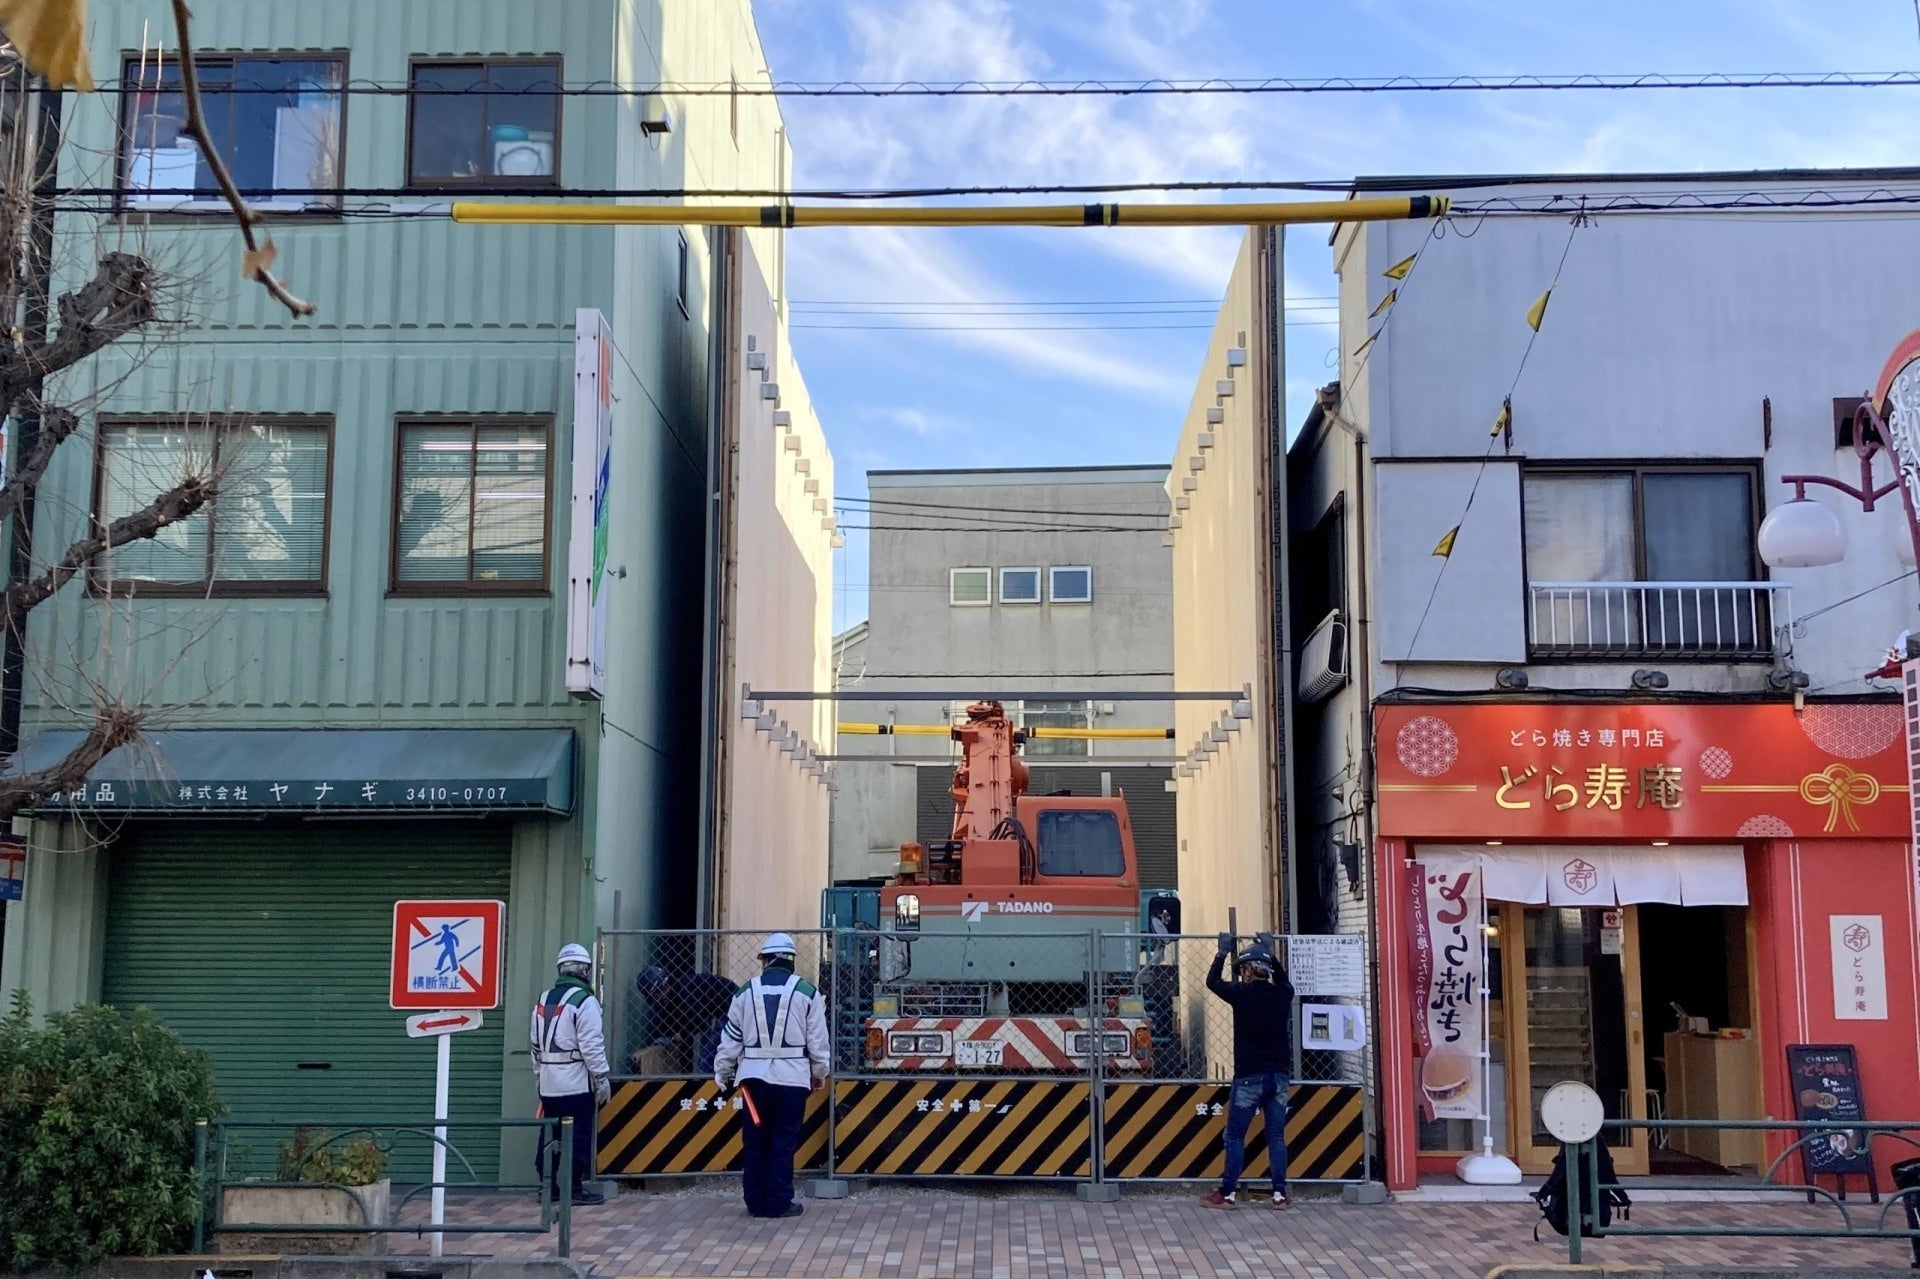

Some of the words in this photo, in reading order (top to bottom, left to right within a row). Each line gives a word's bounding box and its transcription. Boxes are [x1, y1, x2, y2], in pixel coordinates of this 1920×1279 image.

[1510, 728, 1664, 748] どら焼き専門店
[178, 785, 248, 800] 株式会社
[269, 782, 379, 801] ヤナギ
[406, 787, 507, 800] 3410-0707
[1495, 763, 1684, 811] どら寿庵
[997, 902, 1053, 913] TADANO
[413, 976, 461, 990] 横断禁止
[1853, 957, 1867, 1012] どら寿庵
[680, 1098, 708, 1110] 安全
[917, 1099, 944, 1111] 安全
[1195, 1102, 1224, 1115] 安全
